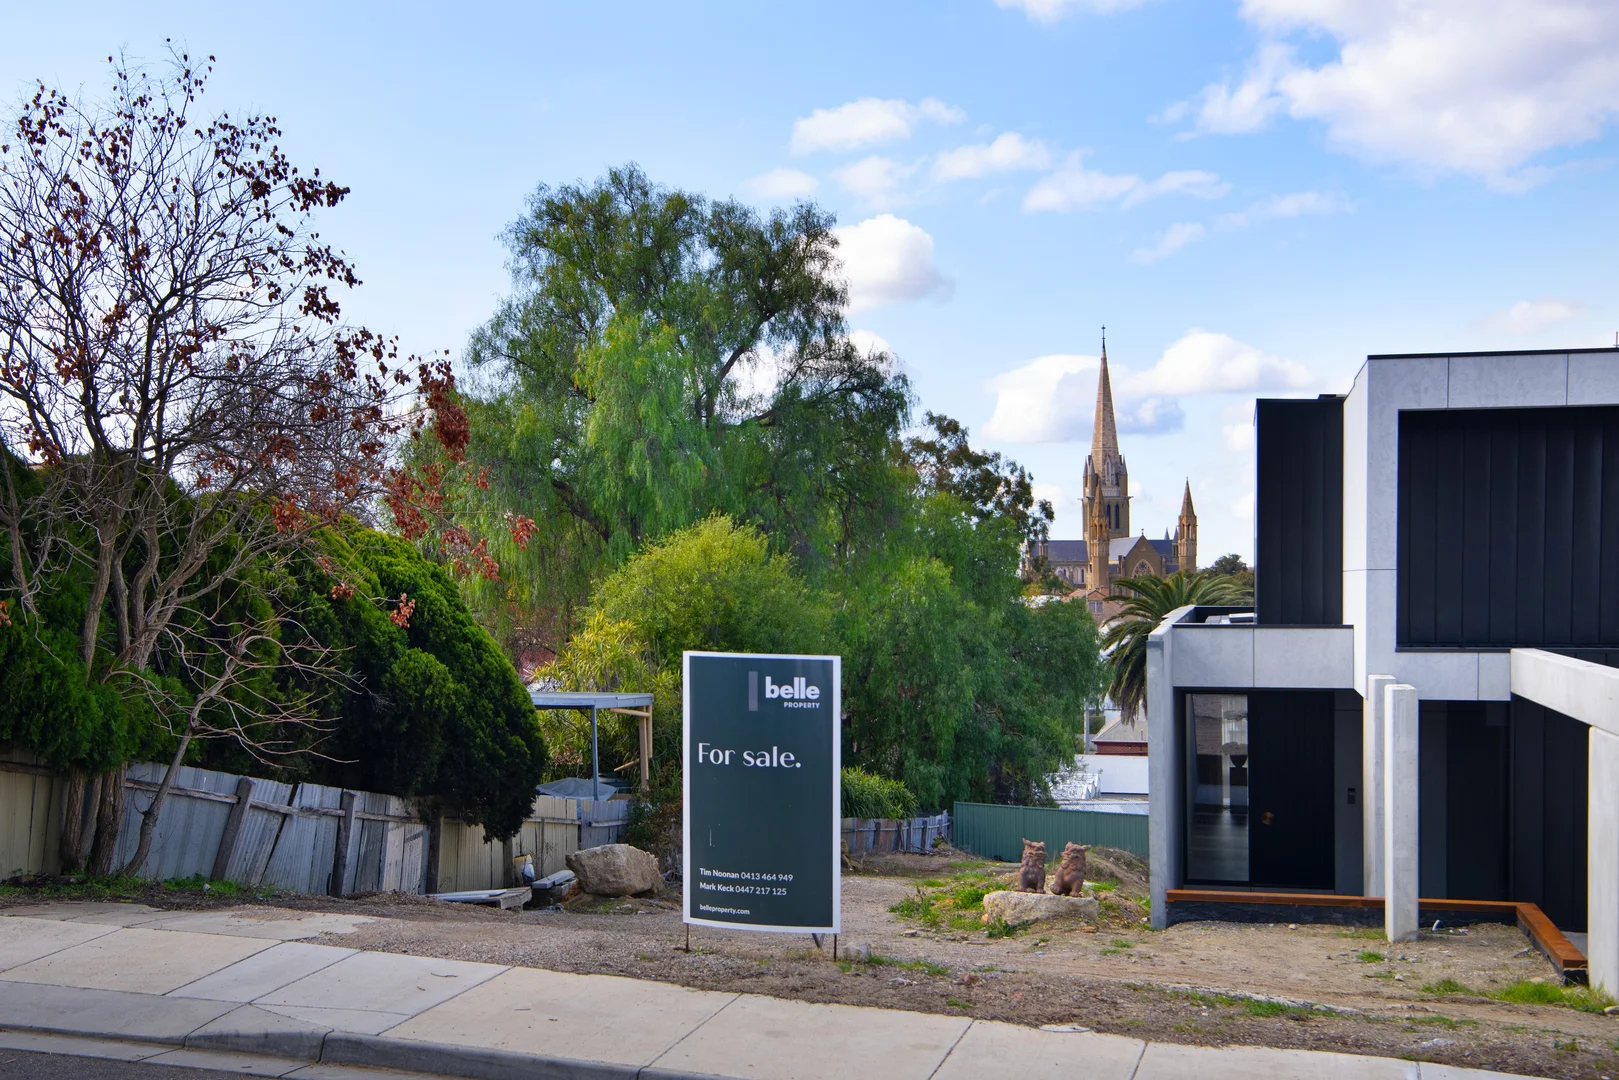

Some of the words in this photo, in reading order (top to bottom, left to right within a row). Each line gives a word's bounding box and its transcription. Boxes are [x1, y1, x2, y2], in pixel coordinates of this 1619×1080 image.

[765, 676, 820, 699] belle
[698, 742, 736, 765] For
[742, 746, 801, 768] sale.
[700, 868, 712, 876] Tim
[712, 870, 740, 879] Noonan
[740, 872, 760, 880] 0413
[700, 882, 716, 890] Mark
[718, 884, 734, 892] Keck
[735, 886, 754, 894] 0447
[700, 904, 750, 914] belleproperty.com
